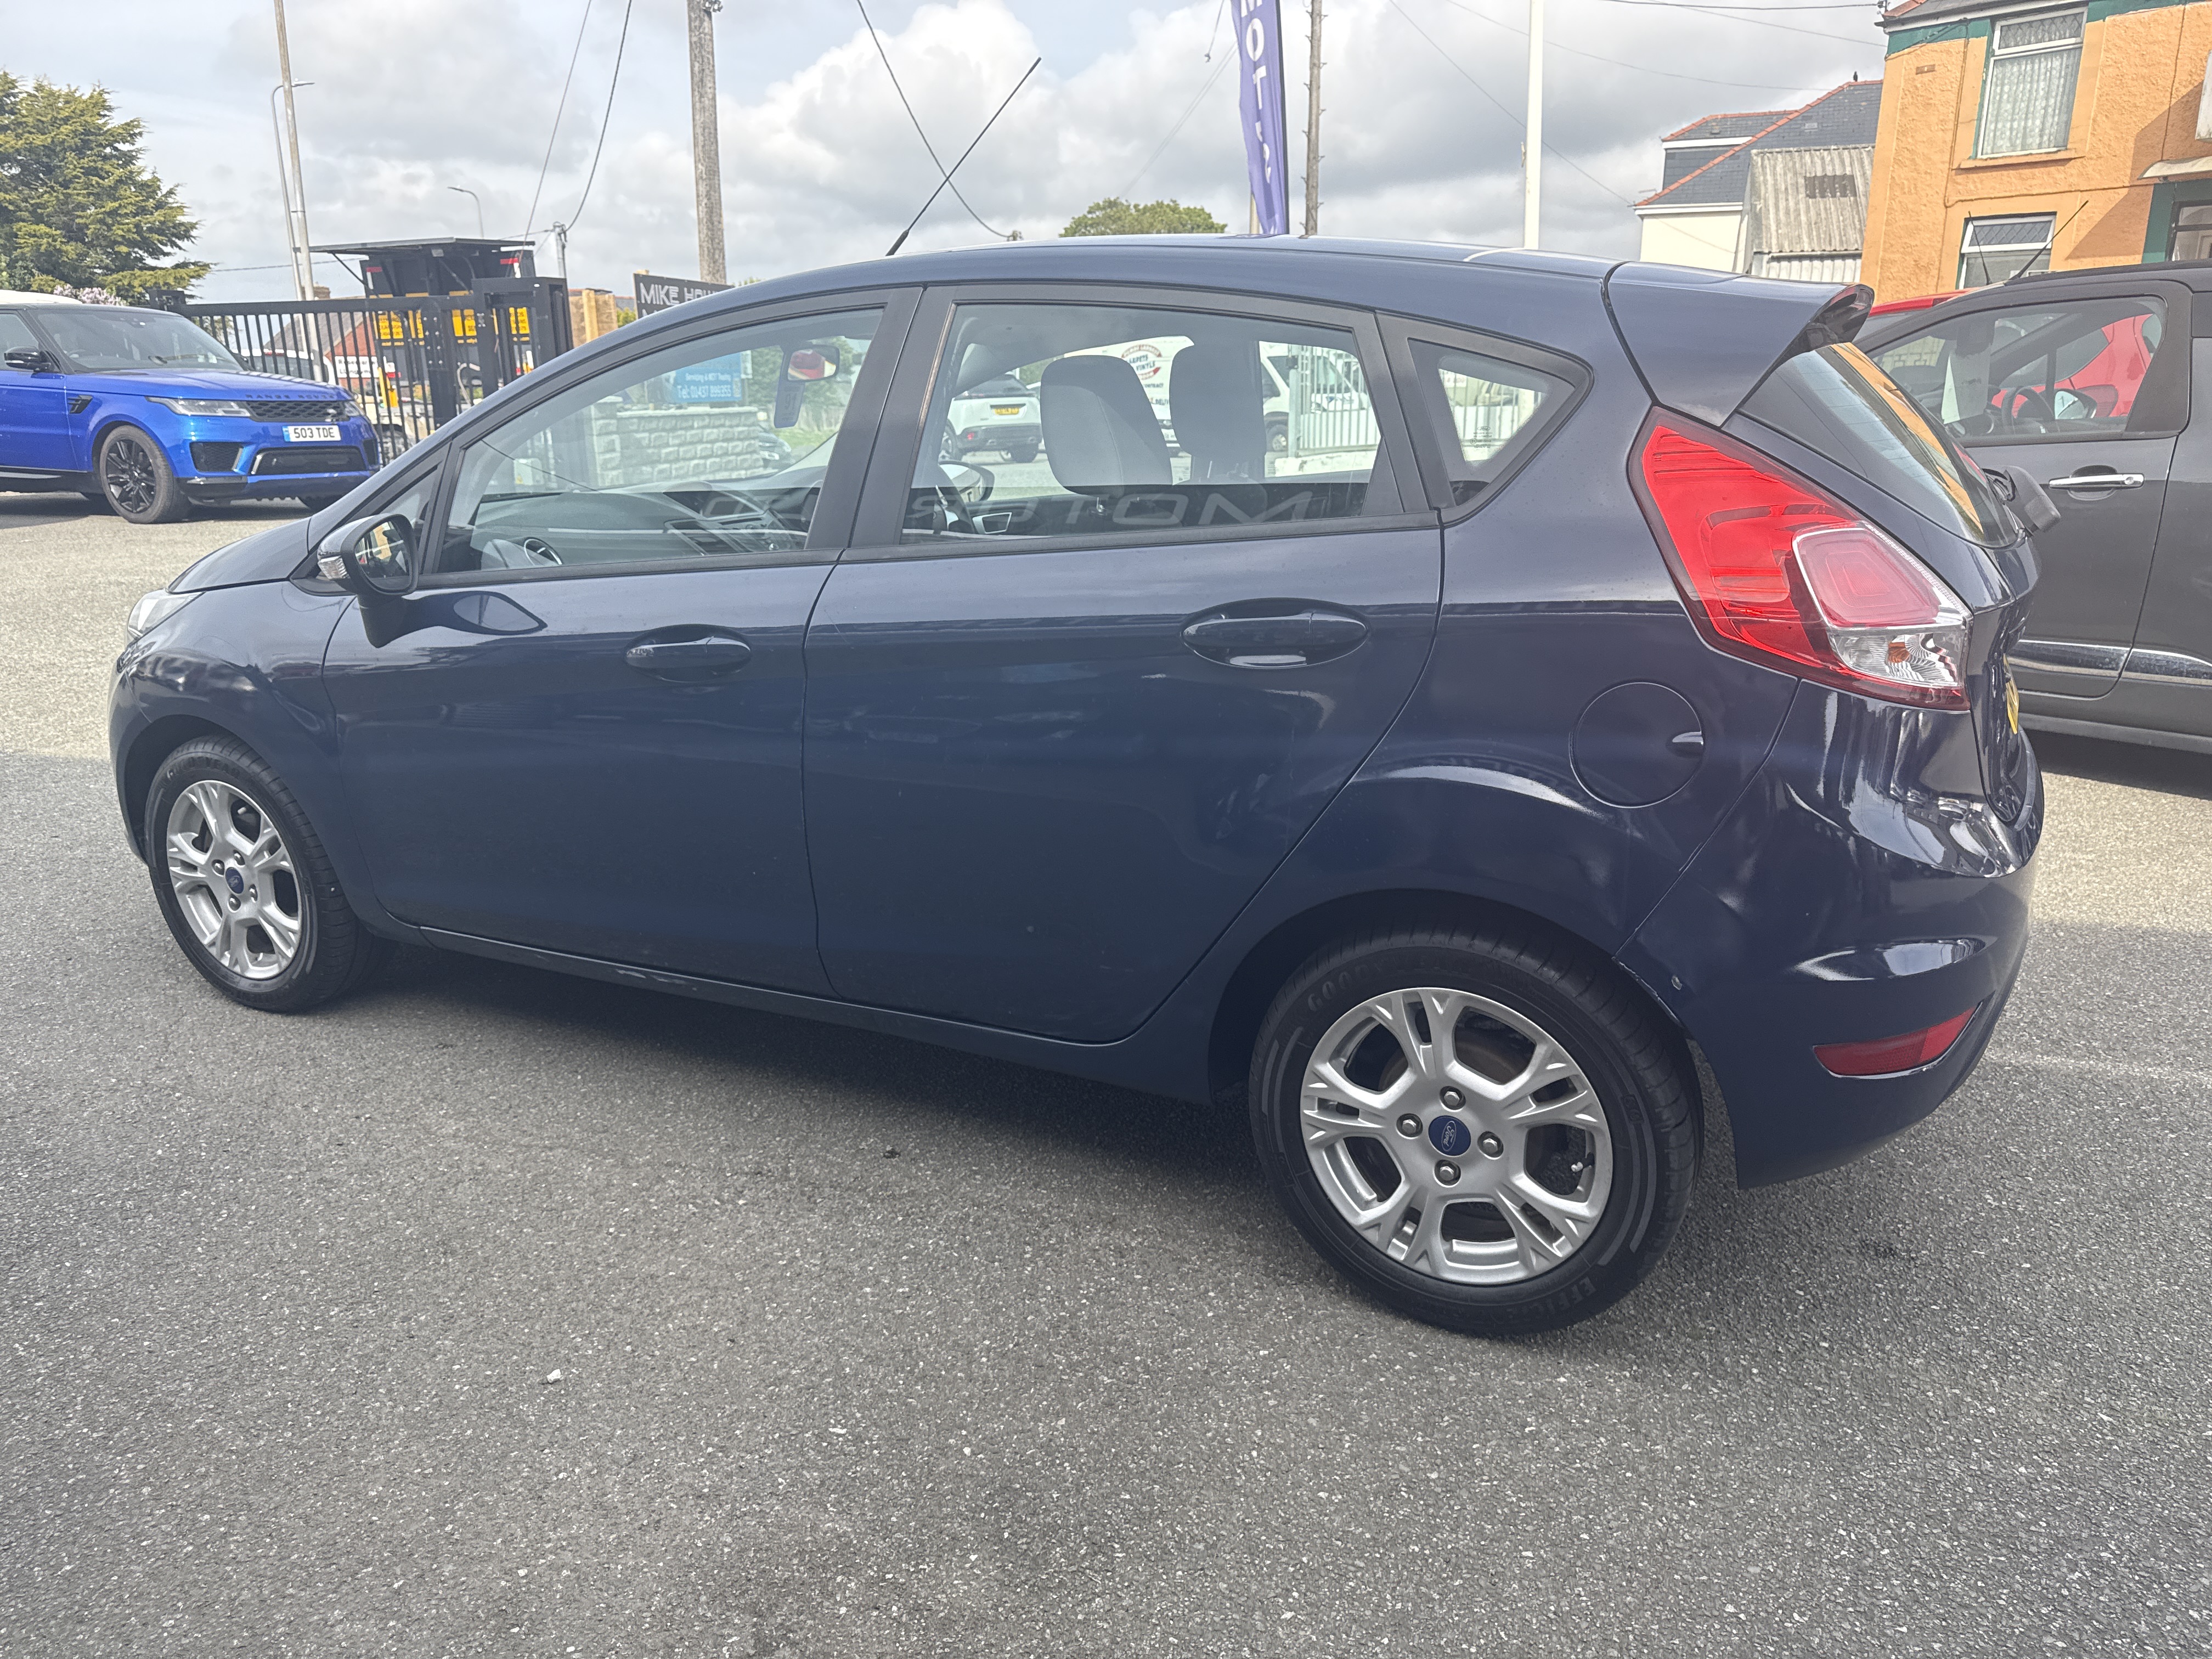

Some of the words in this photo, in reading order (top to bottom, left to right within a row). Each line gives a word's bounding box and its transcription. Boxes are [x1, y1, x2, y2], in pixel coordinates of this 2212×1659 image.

[640, 282, 680, 306] MIKE
[294, 427, 314, 439] 503
[315, 427, 335, 438] TDE
[1442, 1123, 1456, 1148] Ford
